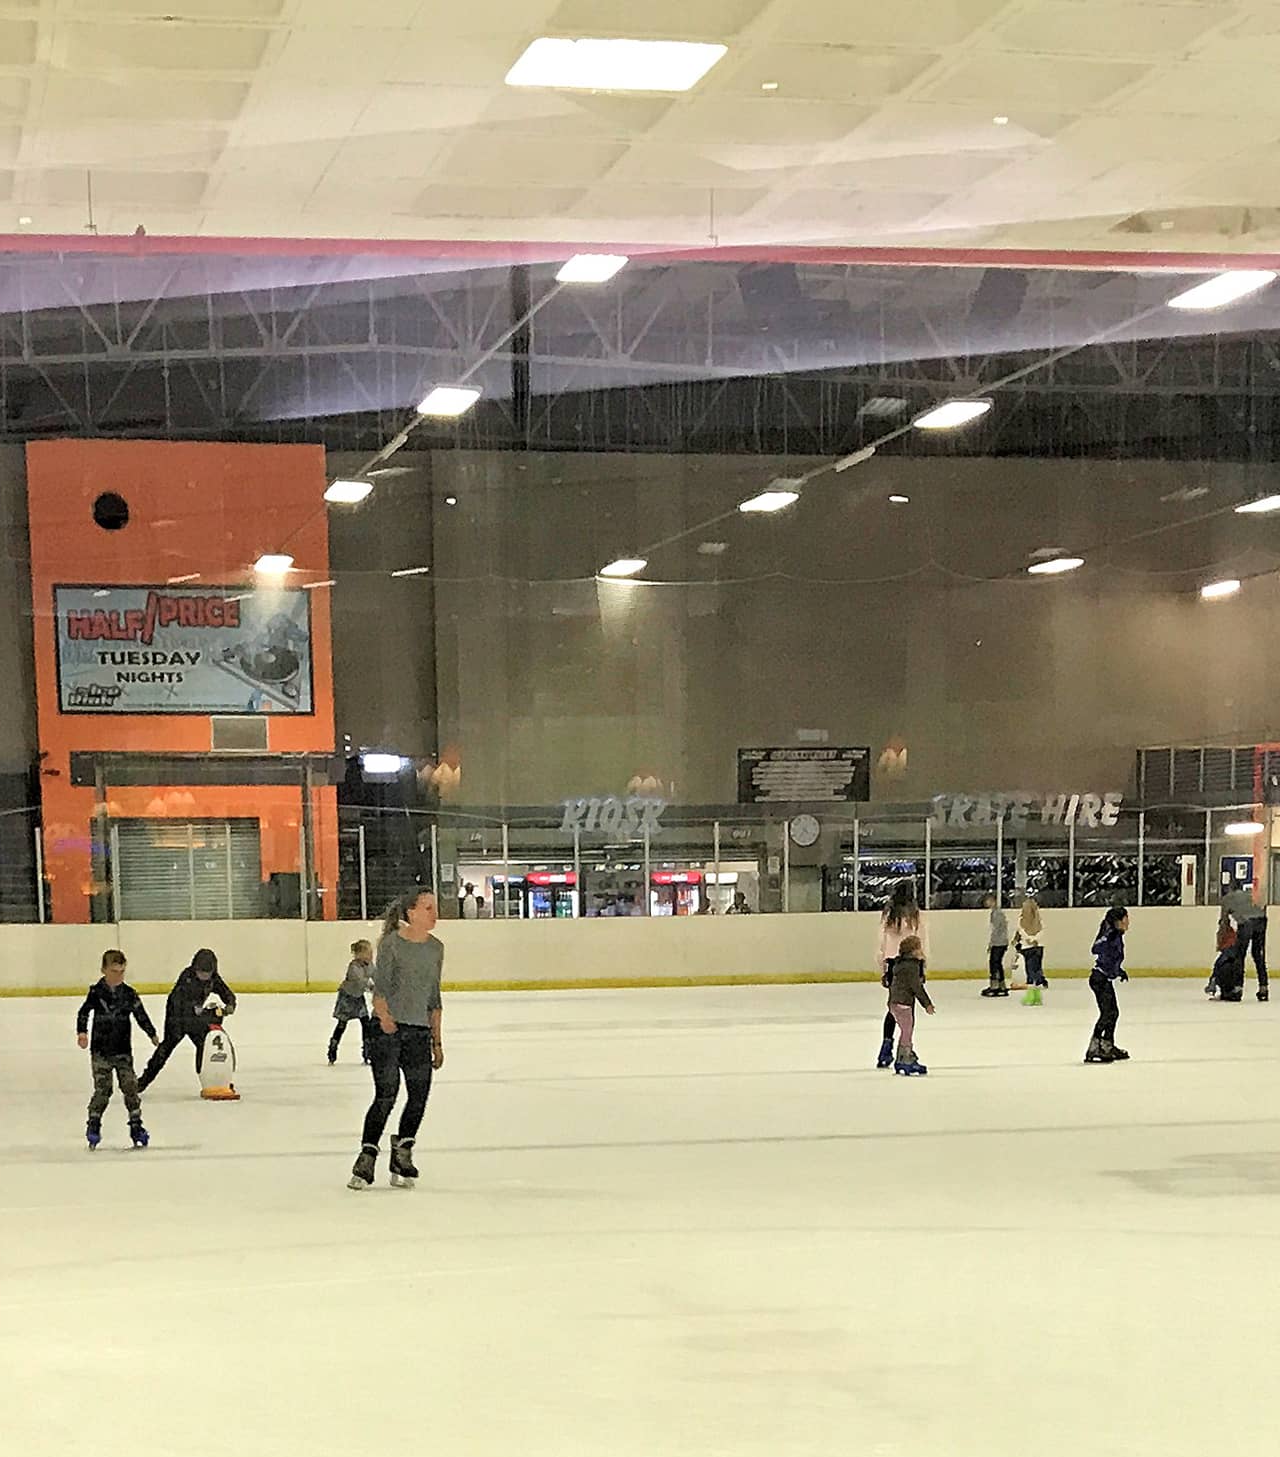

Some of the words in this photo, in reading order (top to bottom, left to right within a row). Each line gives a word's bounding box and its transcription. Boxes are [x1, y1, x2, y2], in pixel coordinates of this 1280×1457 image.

[97, 651, 200, 665] TUESDAY
[116, 671, 184, 683] NIGHTS
[932, 793, 1034, 830] SKATE
[1041, 792, 1124, 828] HIRE
